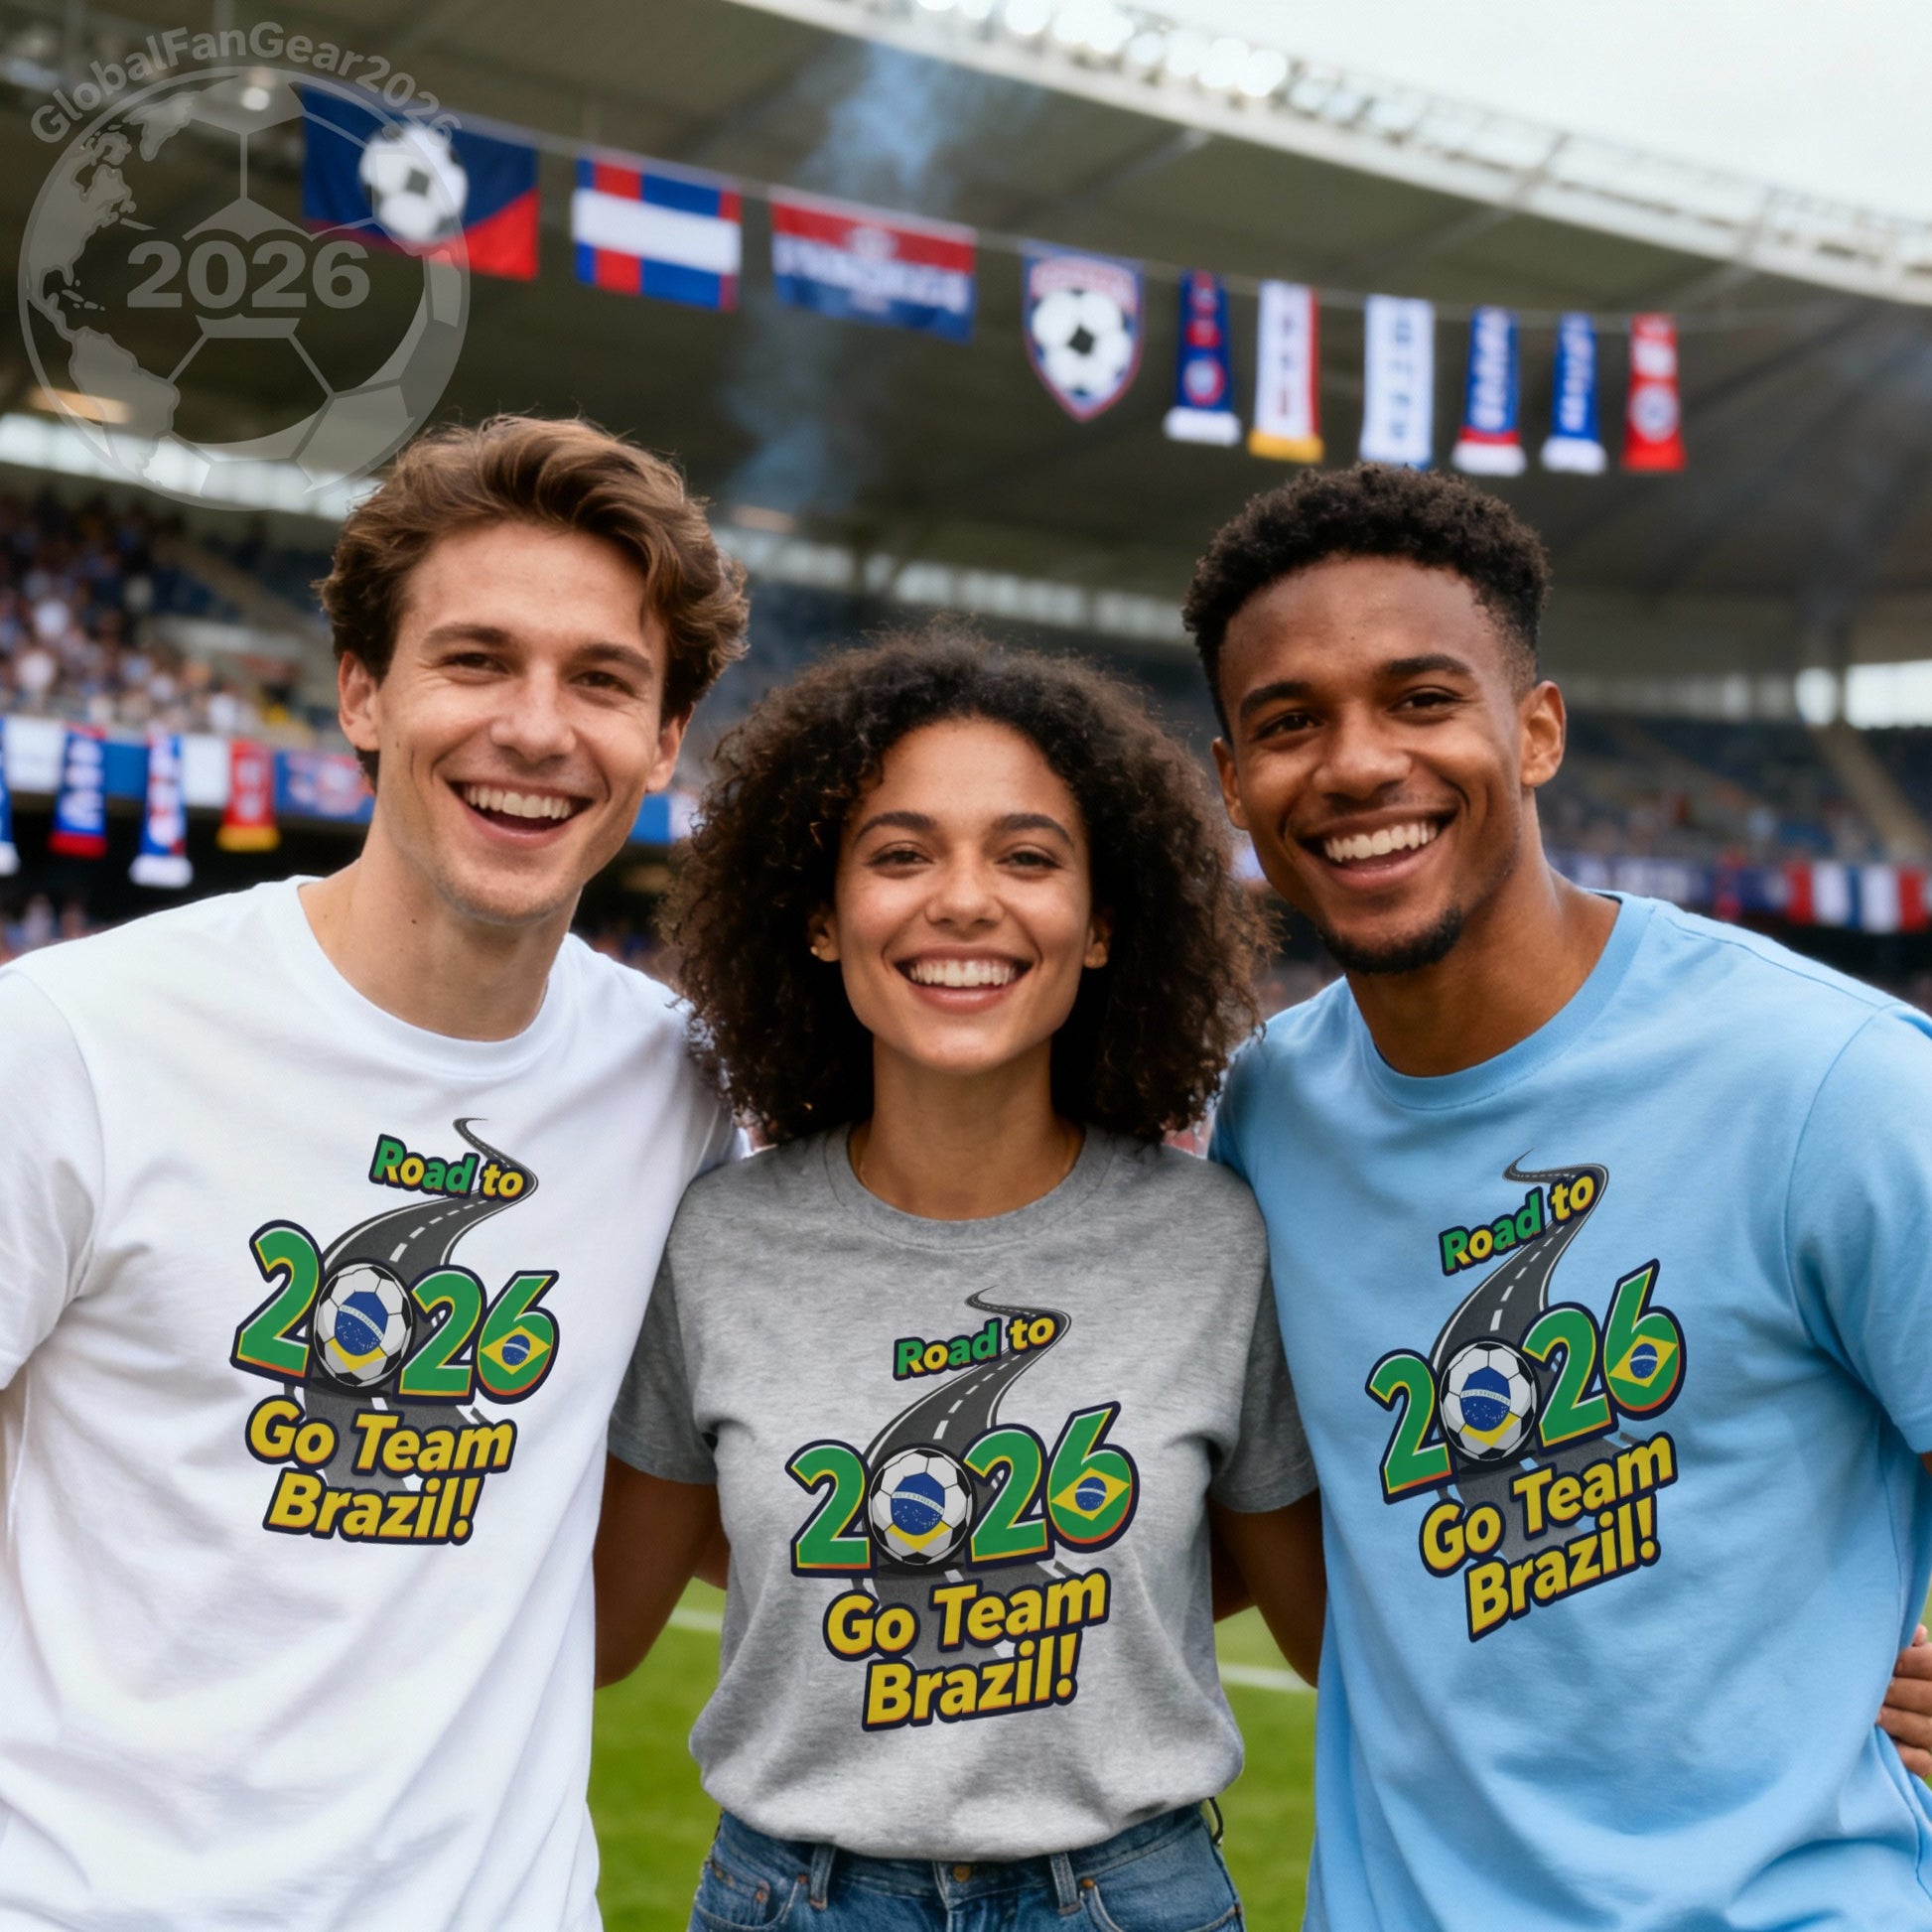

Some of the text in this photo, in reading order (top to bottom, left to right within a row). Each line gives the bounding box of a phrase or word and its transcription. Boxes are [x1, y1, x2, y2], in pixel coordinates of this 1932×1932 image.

[371, 1137, 526, 1199] Road to
[1442, 1173, 1595, 1273] Road to
[895, 1315, 1056, 1378] Road to
[248, 1397, 515, 1474] Go Team
[265, 1469, 483, 1541] Brazil!
[1421, 1435, 1675, 1574] Go Team
[1467, 1494, 1658, 1638] Brazil!
[825, 1571, 1108, 1658] Go Team
[865, 1631, 1079, 1728] Brazil!
